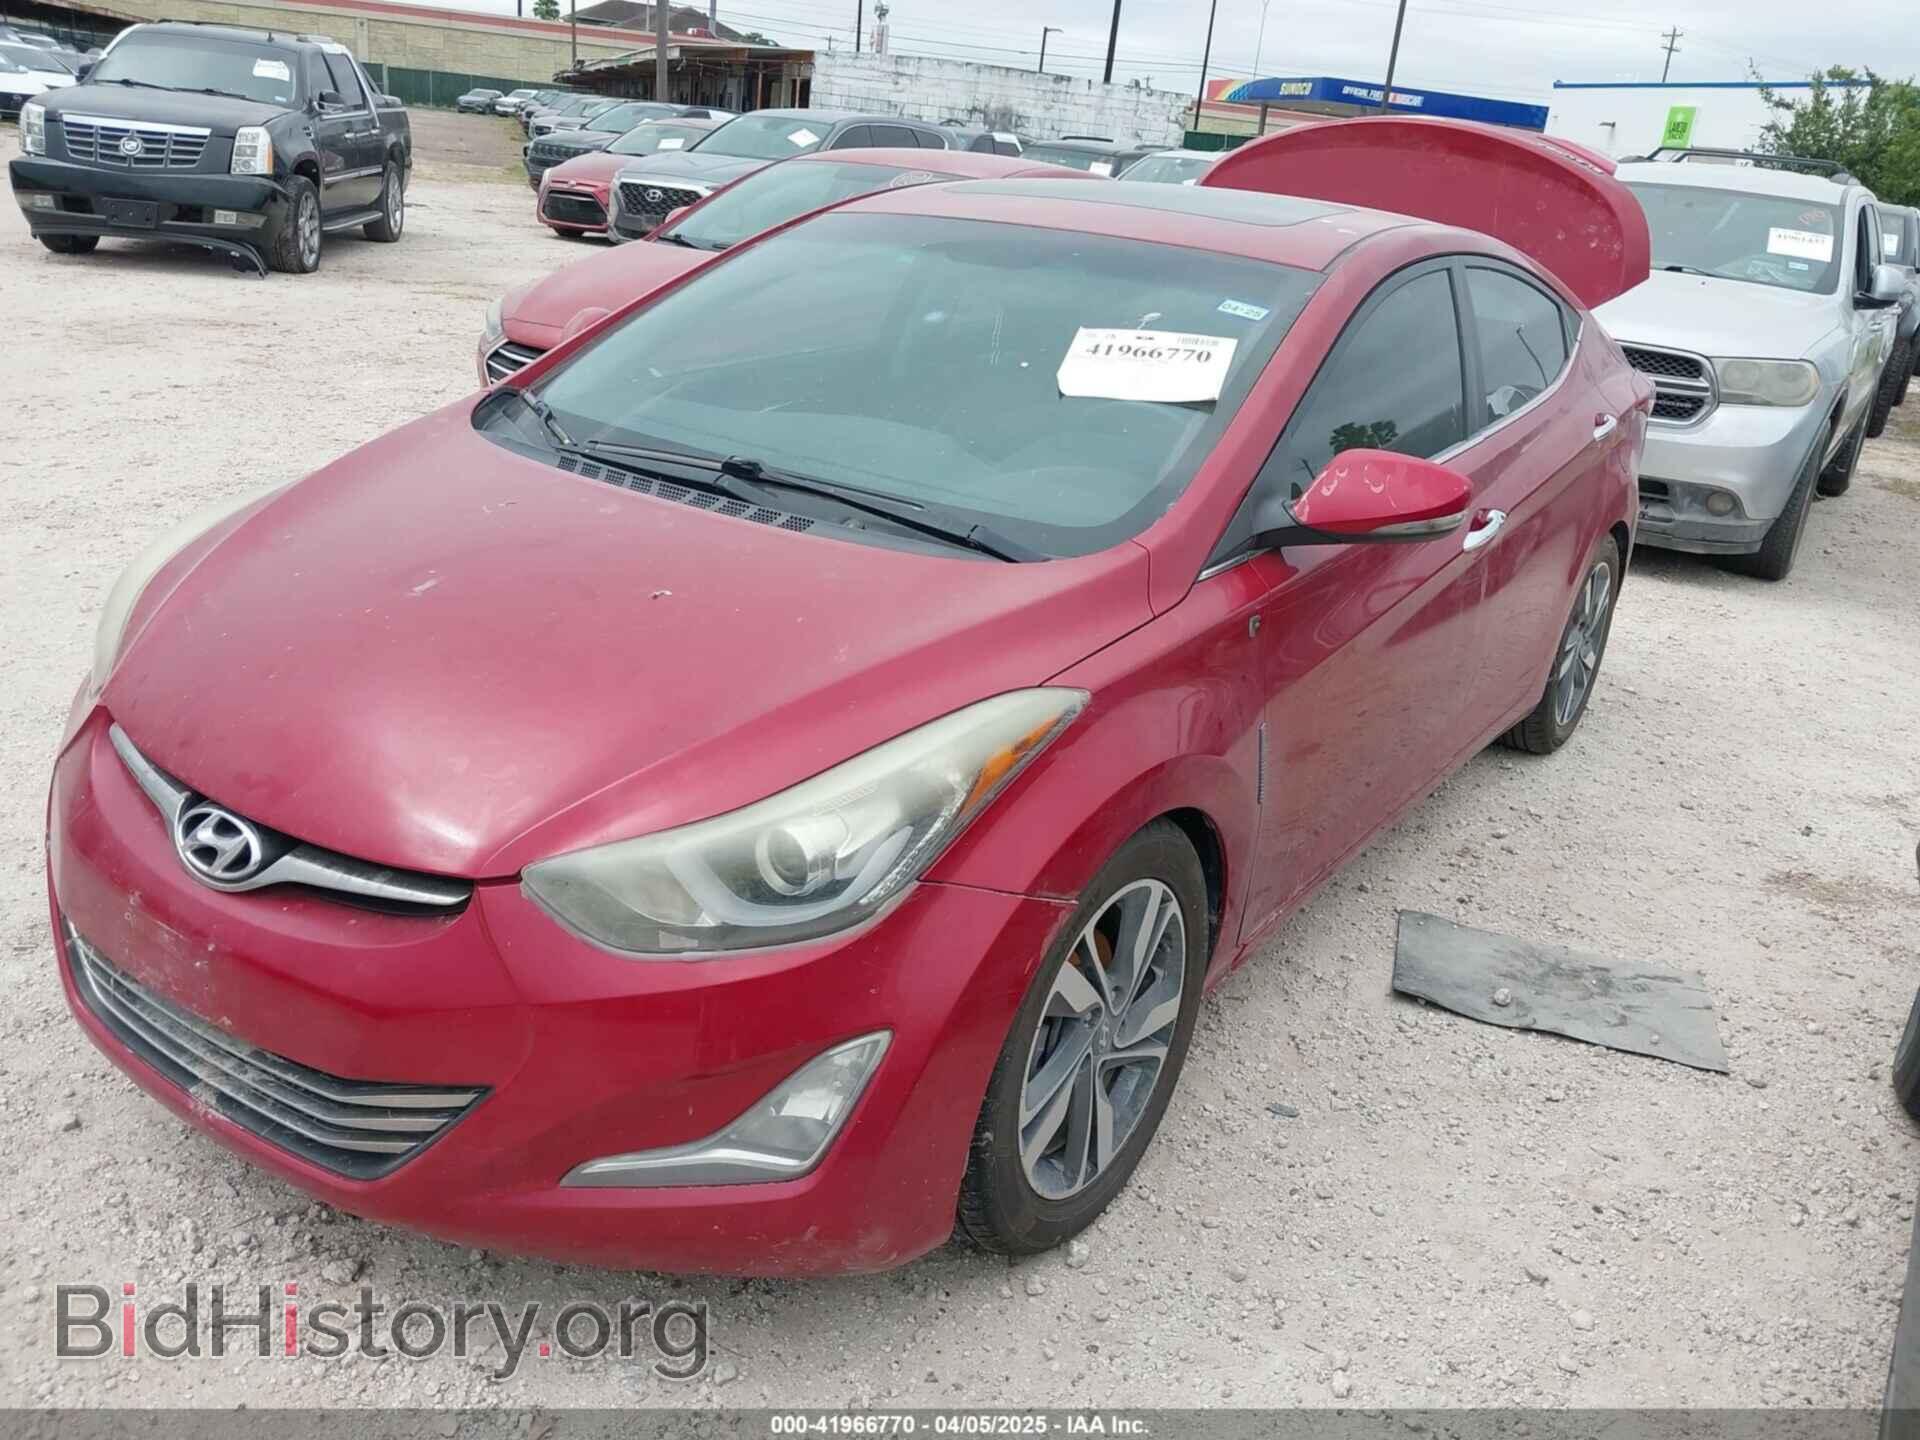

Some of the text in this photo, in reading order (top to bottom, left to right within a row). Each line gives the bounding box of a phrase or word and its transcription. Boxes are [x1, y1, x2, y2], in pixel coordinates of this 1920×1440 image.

[1279, 82, 1312, 96] SUNOCO
[1342, 85, 1369, 99] OFFICIAL
[1086, 342, 1212, 363] 41966770
